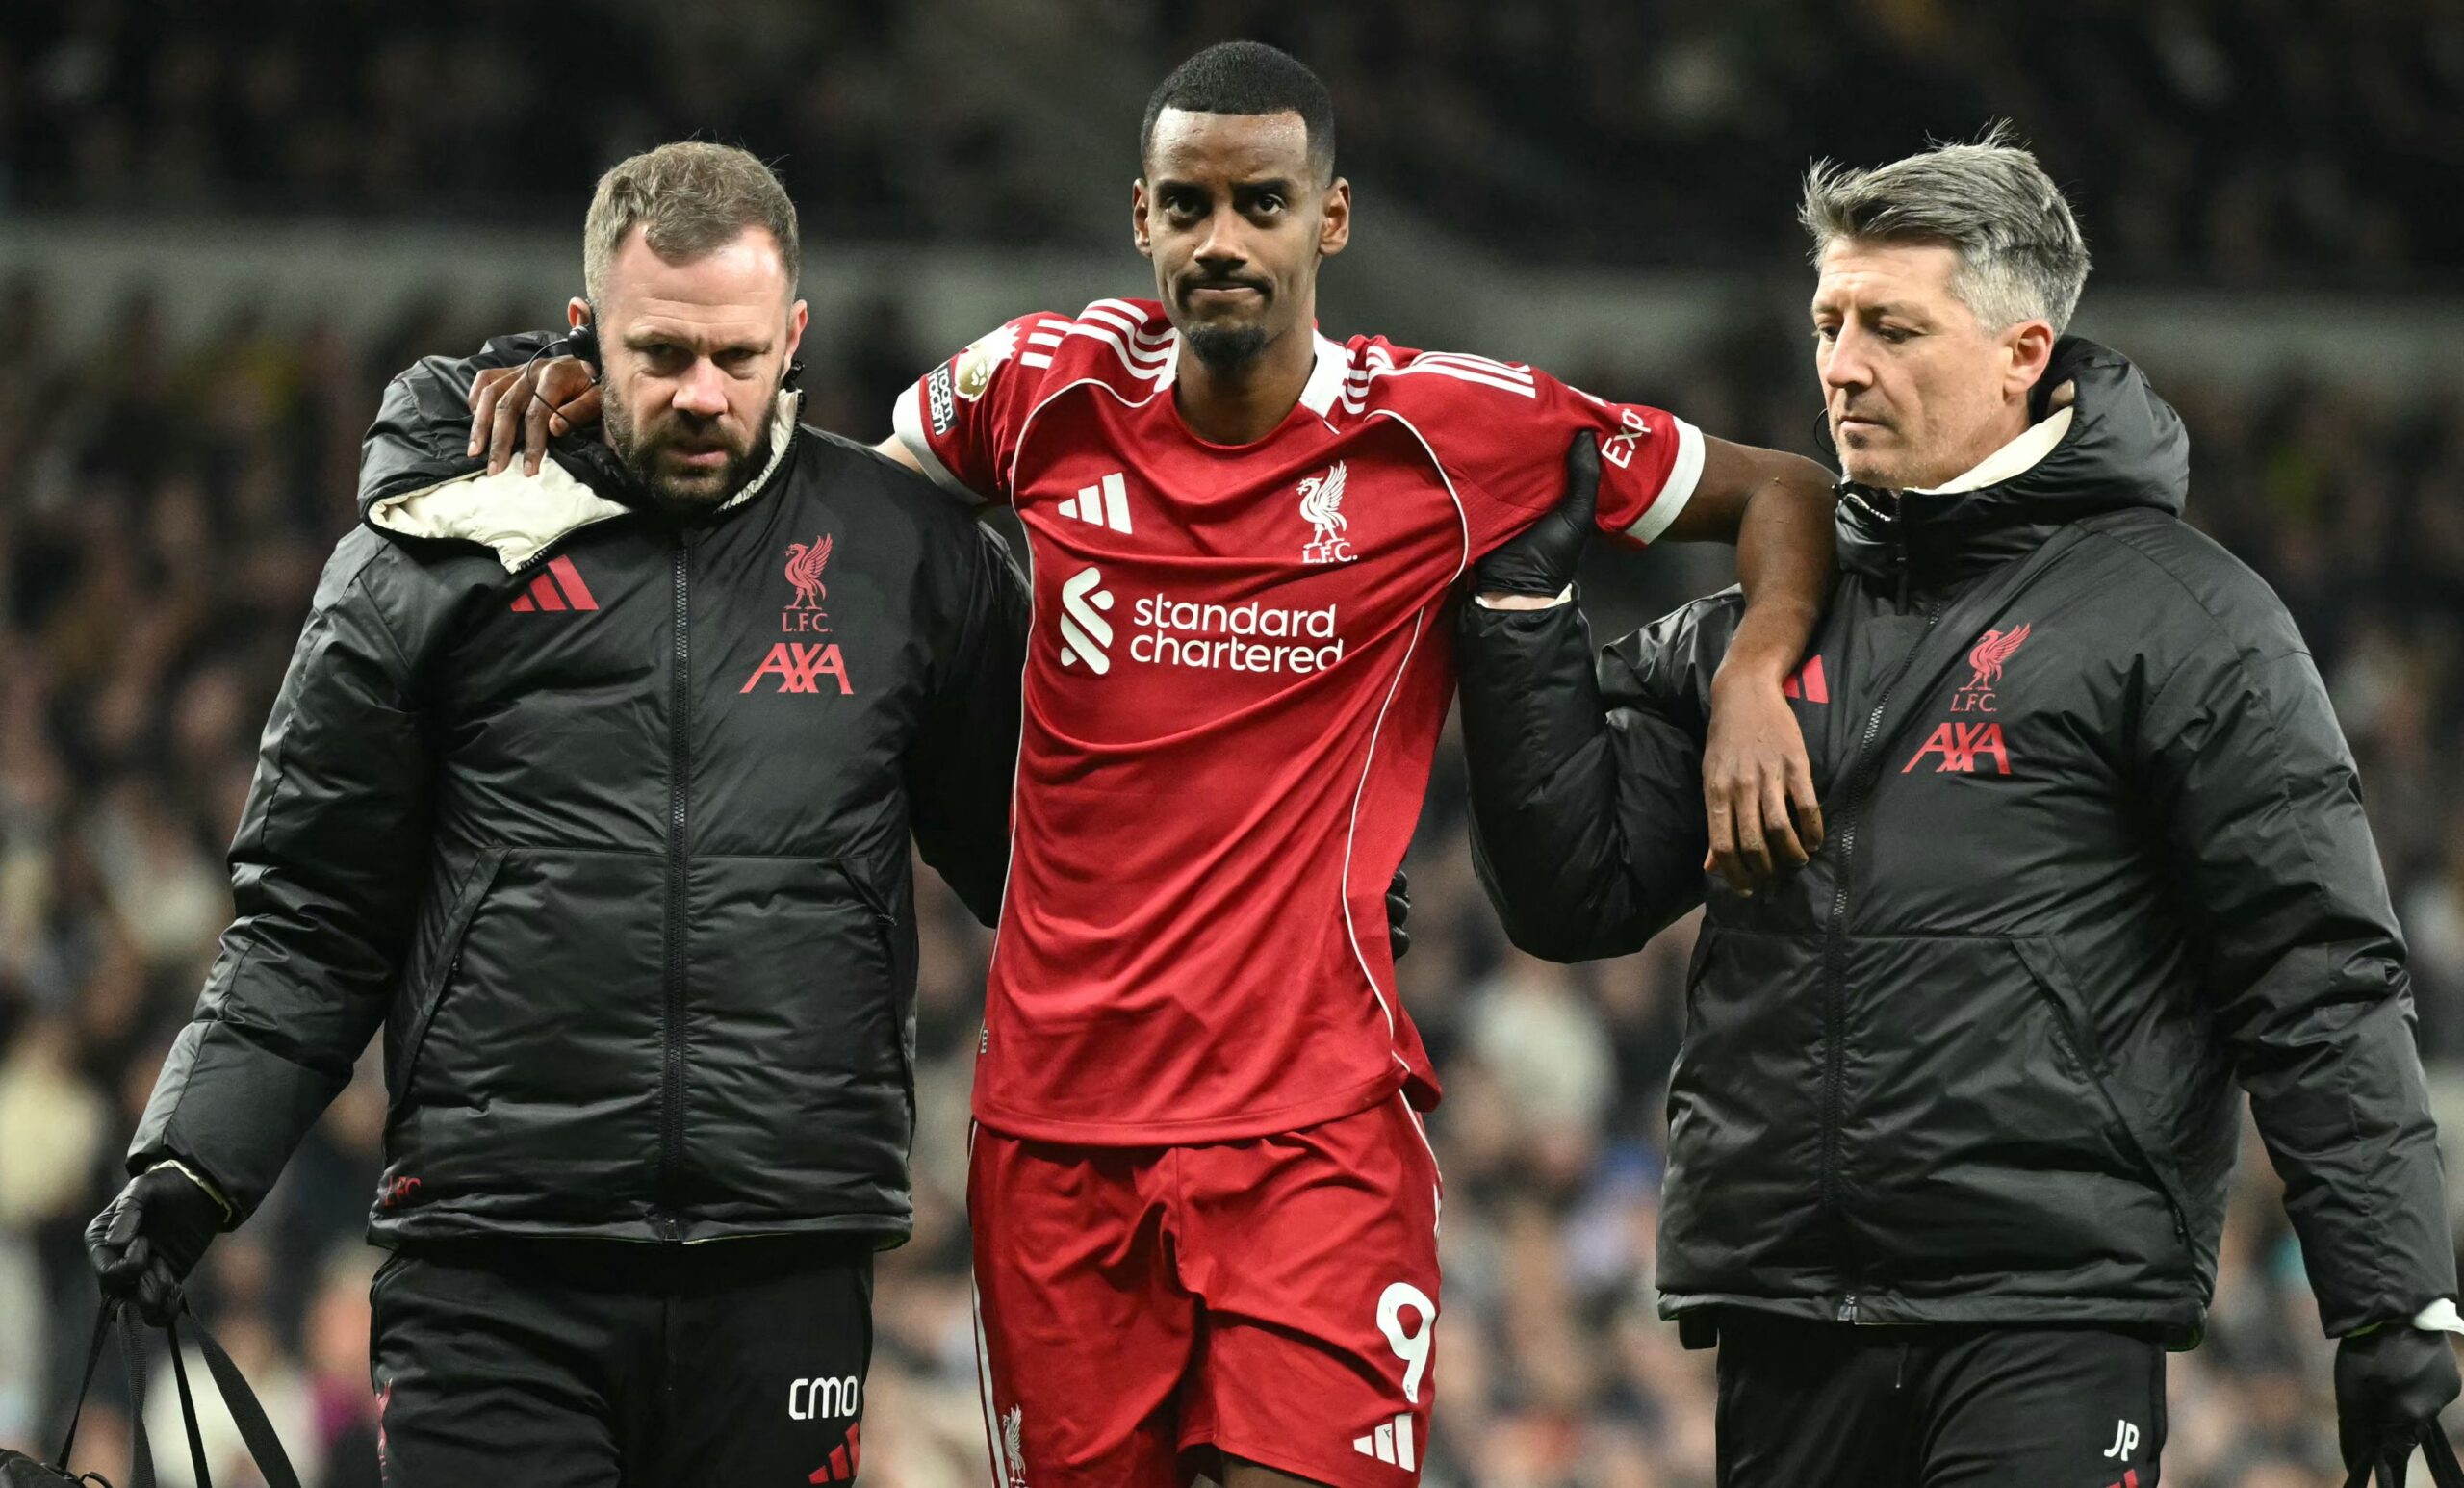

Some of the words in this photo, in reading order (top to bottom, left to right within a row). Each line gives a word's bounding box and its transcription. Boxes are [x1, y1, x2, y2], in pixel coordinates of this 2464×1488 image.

[937, 367, 954, 422] room
[1302, 542, 1358, 564] L.F.C.
[782, 612, 833, 632] L.F.C.
[1133, 592, 1336, 638] standard
[738, 642, 854, 695] AXA
[1130, 629, 1344, 674] chartered
[1950, 693, 1997, 712] L.F.C.
[1901, 722, 2012, 775] AXA
[1375, 1282, 1436, 1404] 9
[2103, 1419, 2140, 1462] JP
